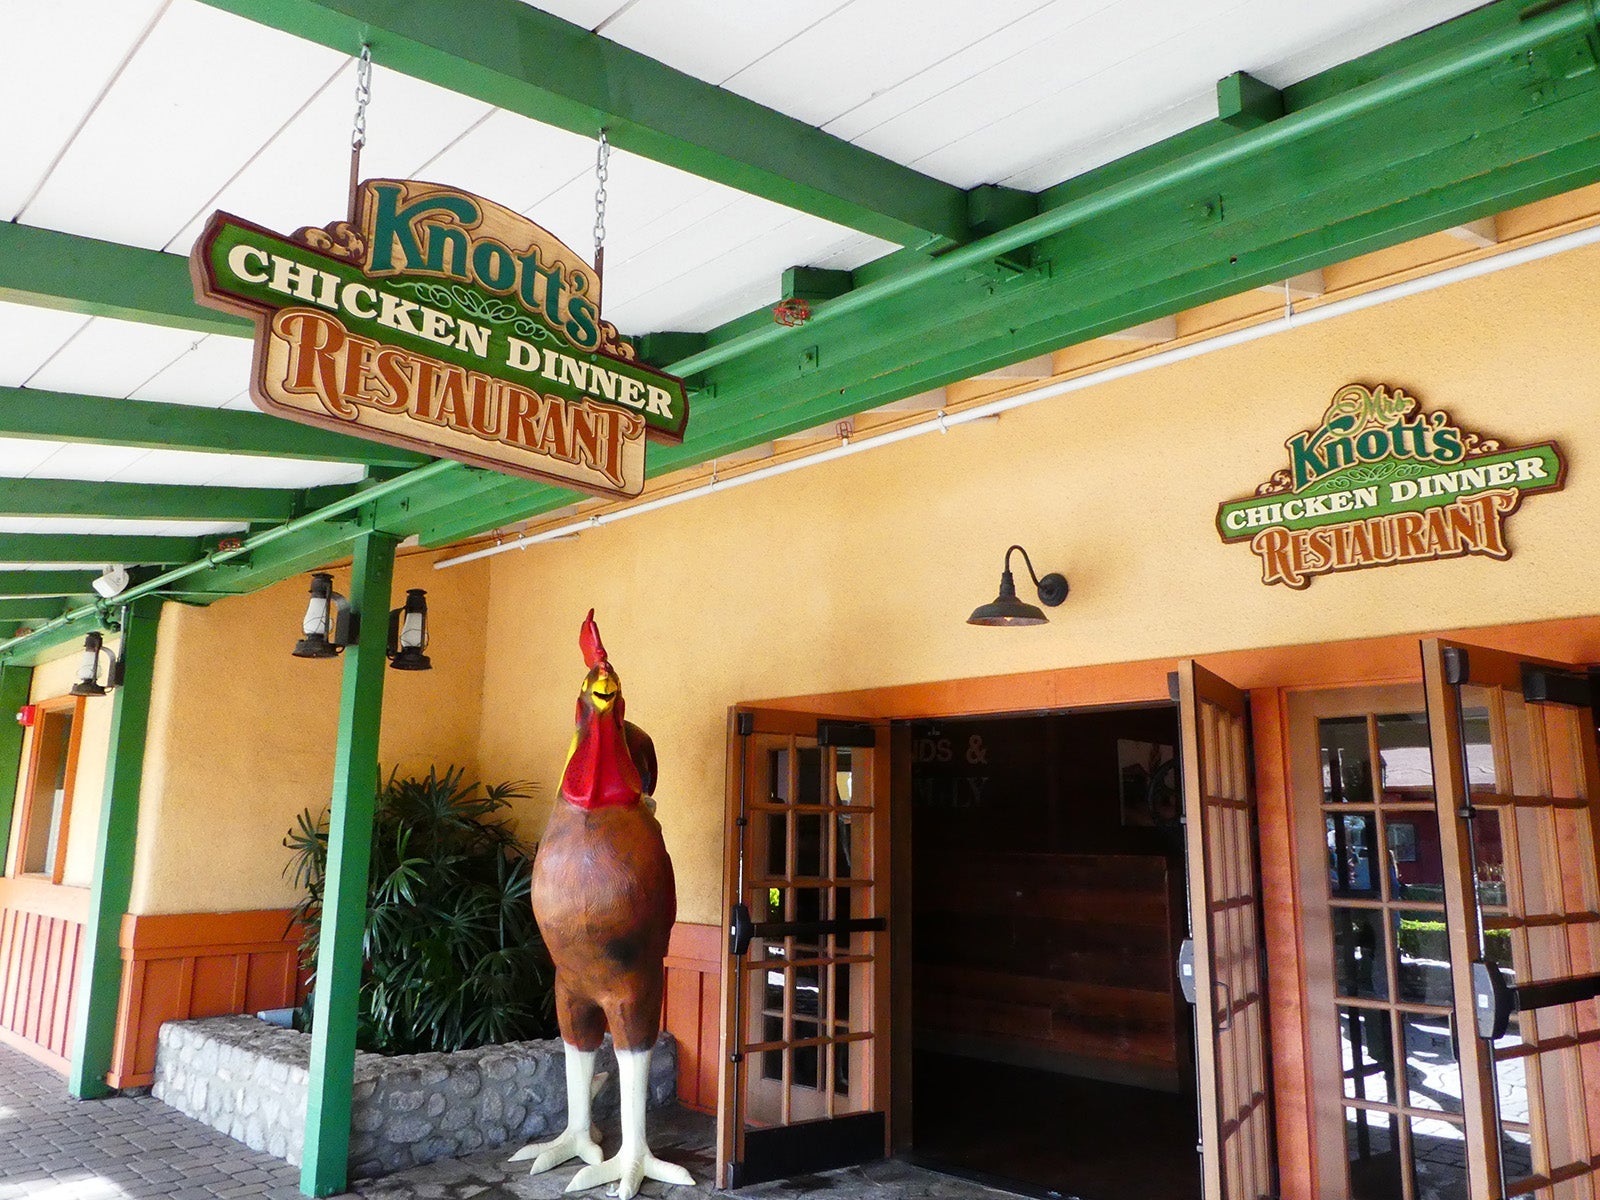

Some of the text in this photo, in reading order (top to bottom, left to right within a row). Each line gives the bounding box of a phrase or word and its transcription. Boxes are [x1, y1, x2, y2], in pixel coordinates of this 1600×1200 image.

[368, 182, 598, 349] Knott's
[227, 244, 674, 420] CHICKEN DINNER
[277, 309, 644, 488] RESTAURANT
[1289, 414, 1462, 490] Knott's
[1226, 456, 1548, 531] CHICKEN DINNER
[1254, 490, 1516, 584] RESTAURANT
